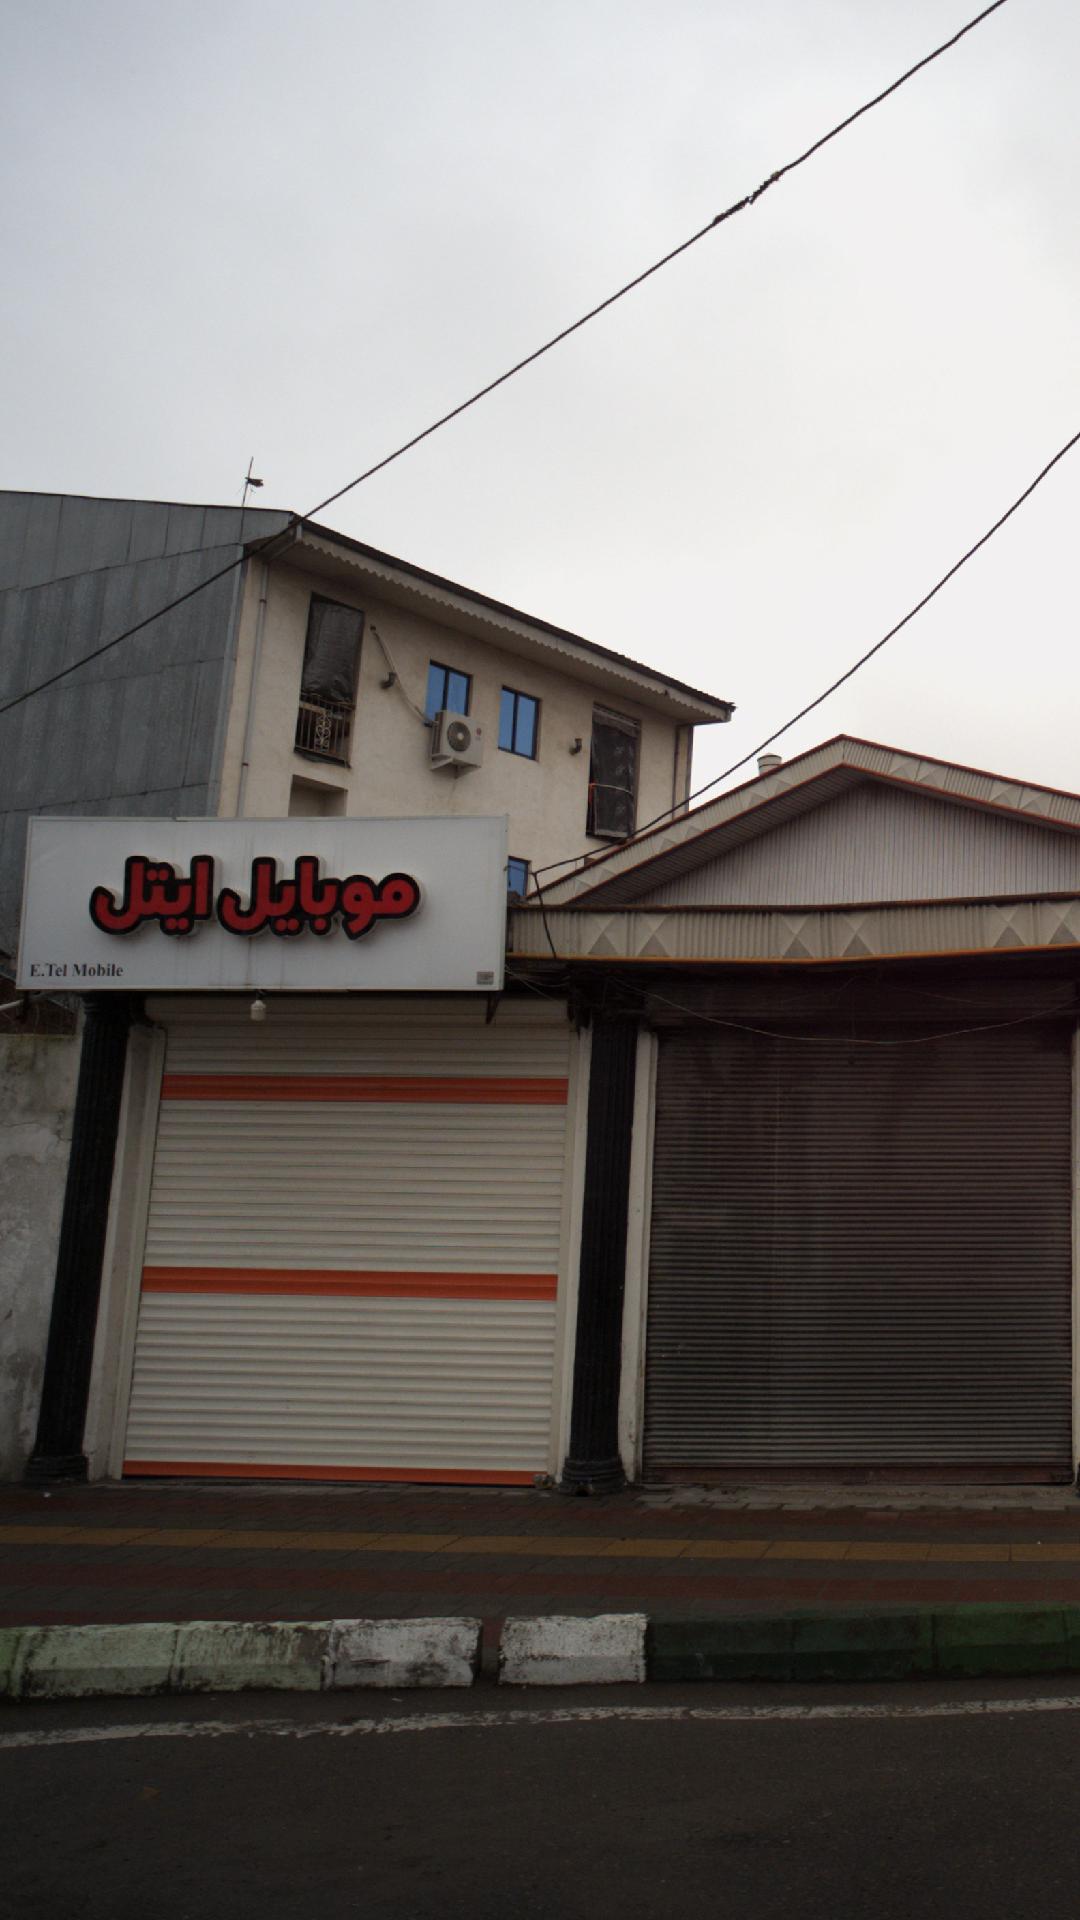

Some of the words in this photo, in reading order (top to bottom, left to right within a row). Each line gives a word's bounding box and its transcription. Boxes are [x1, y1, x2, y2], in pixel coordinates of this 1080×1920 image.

[89, 854, 214, 936] ایتل
[217, 855, 421, 939] موبایل
[30, 963, 67, 977] E.Tel
[72, 963, 124, 977] Mobile
